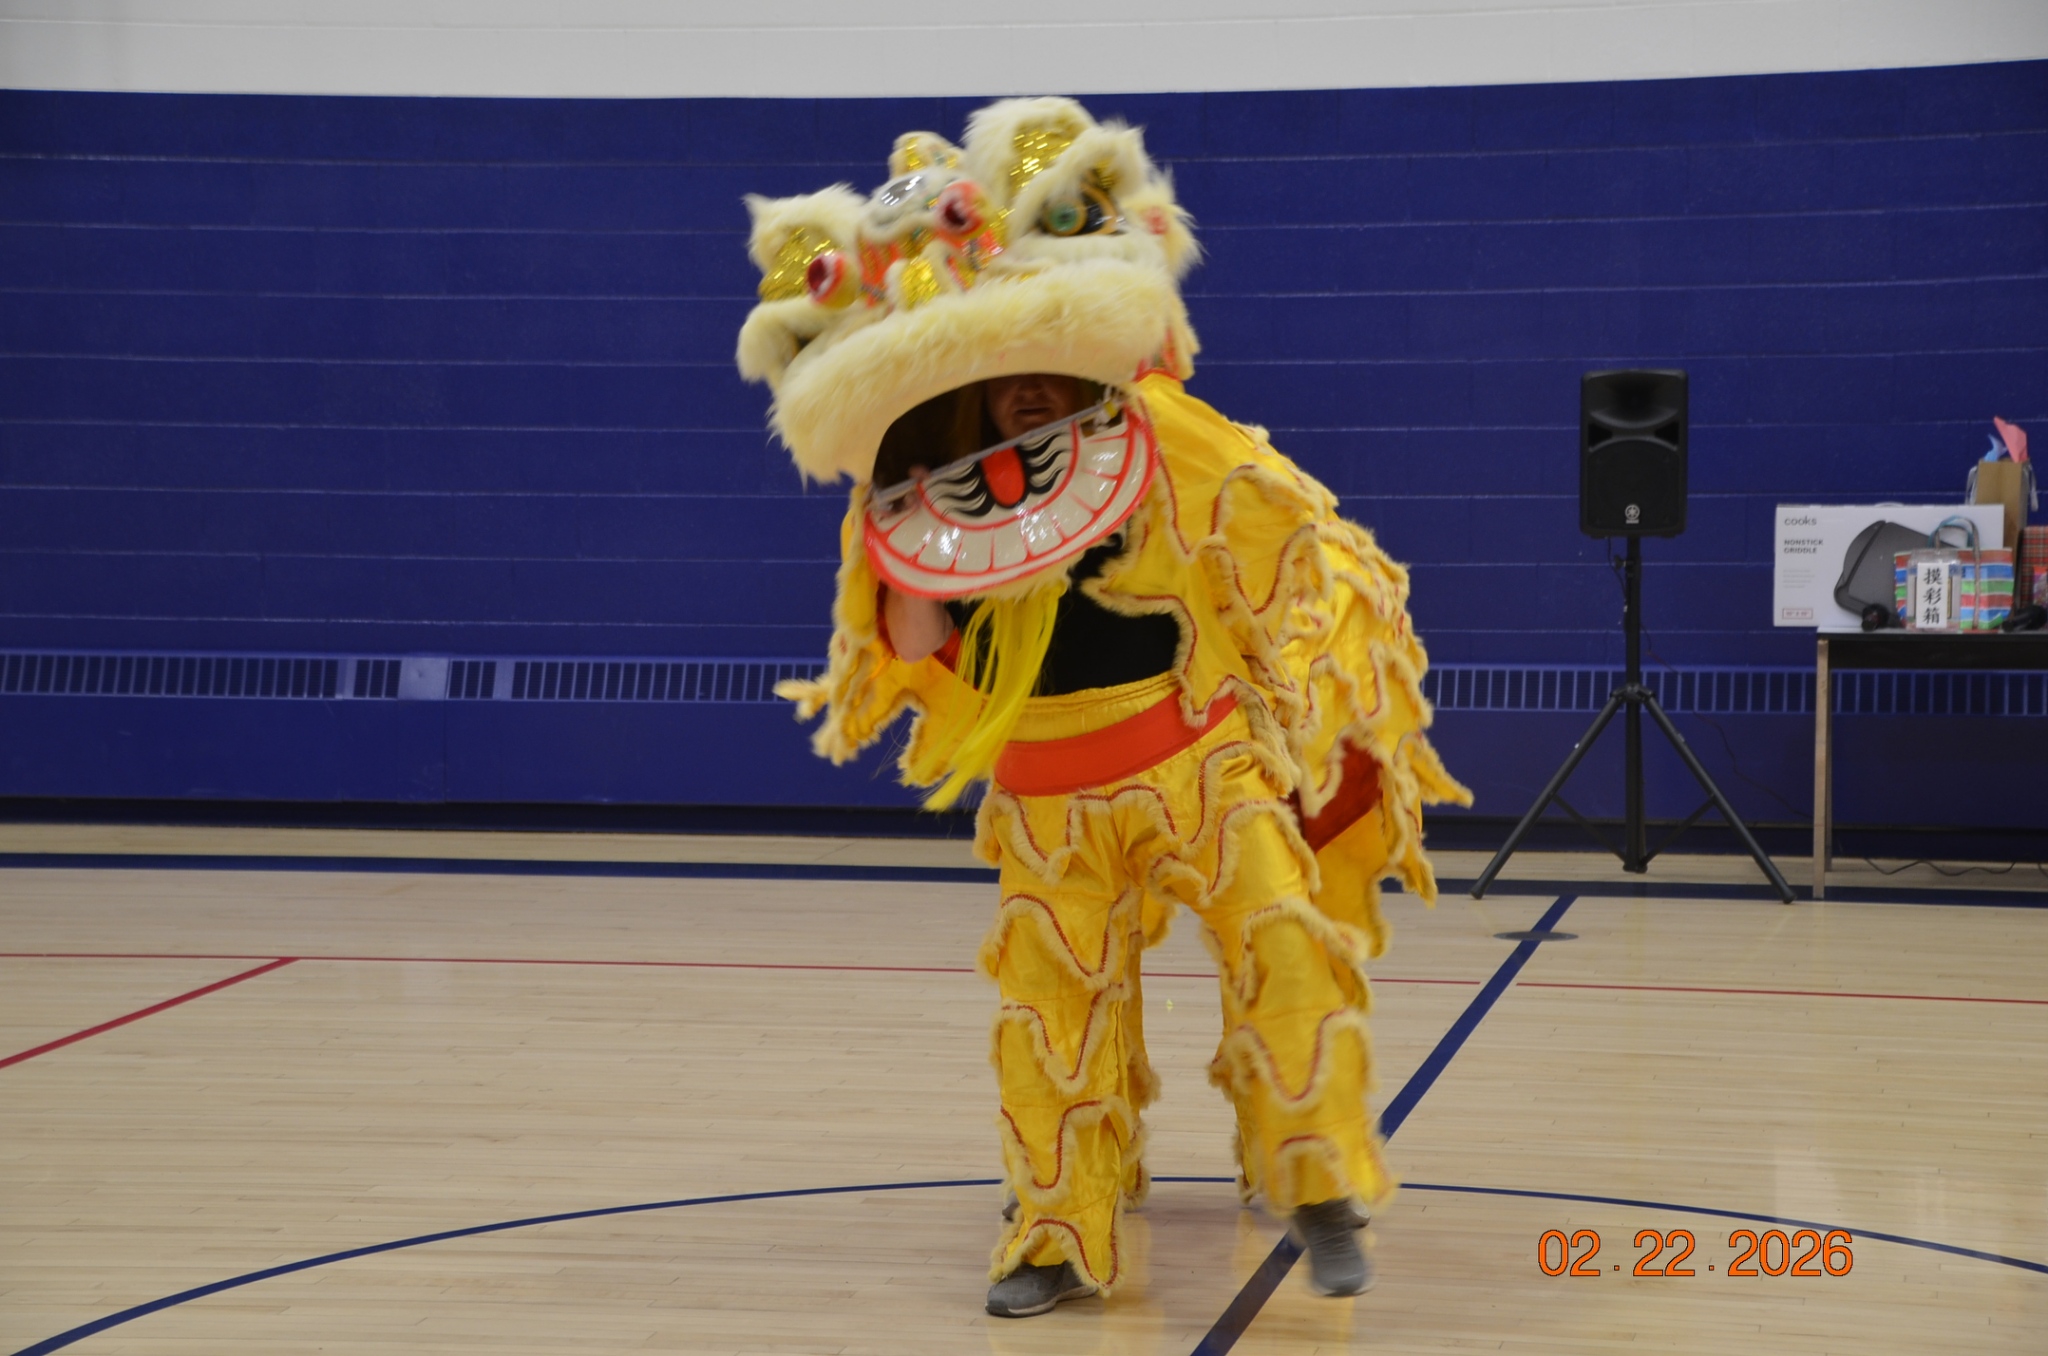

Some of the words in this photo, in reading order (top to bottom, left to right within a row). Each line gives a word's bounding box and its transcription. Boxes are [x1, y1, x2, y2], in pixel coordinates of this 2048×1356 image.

[1784, 515, 1817, 526] cooks
[1923, 567, 1942, 625] 摸彩箱
